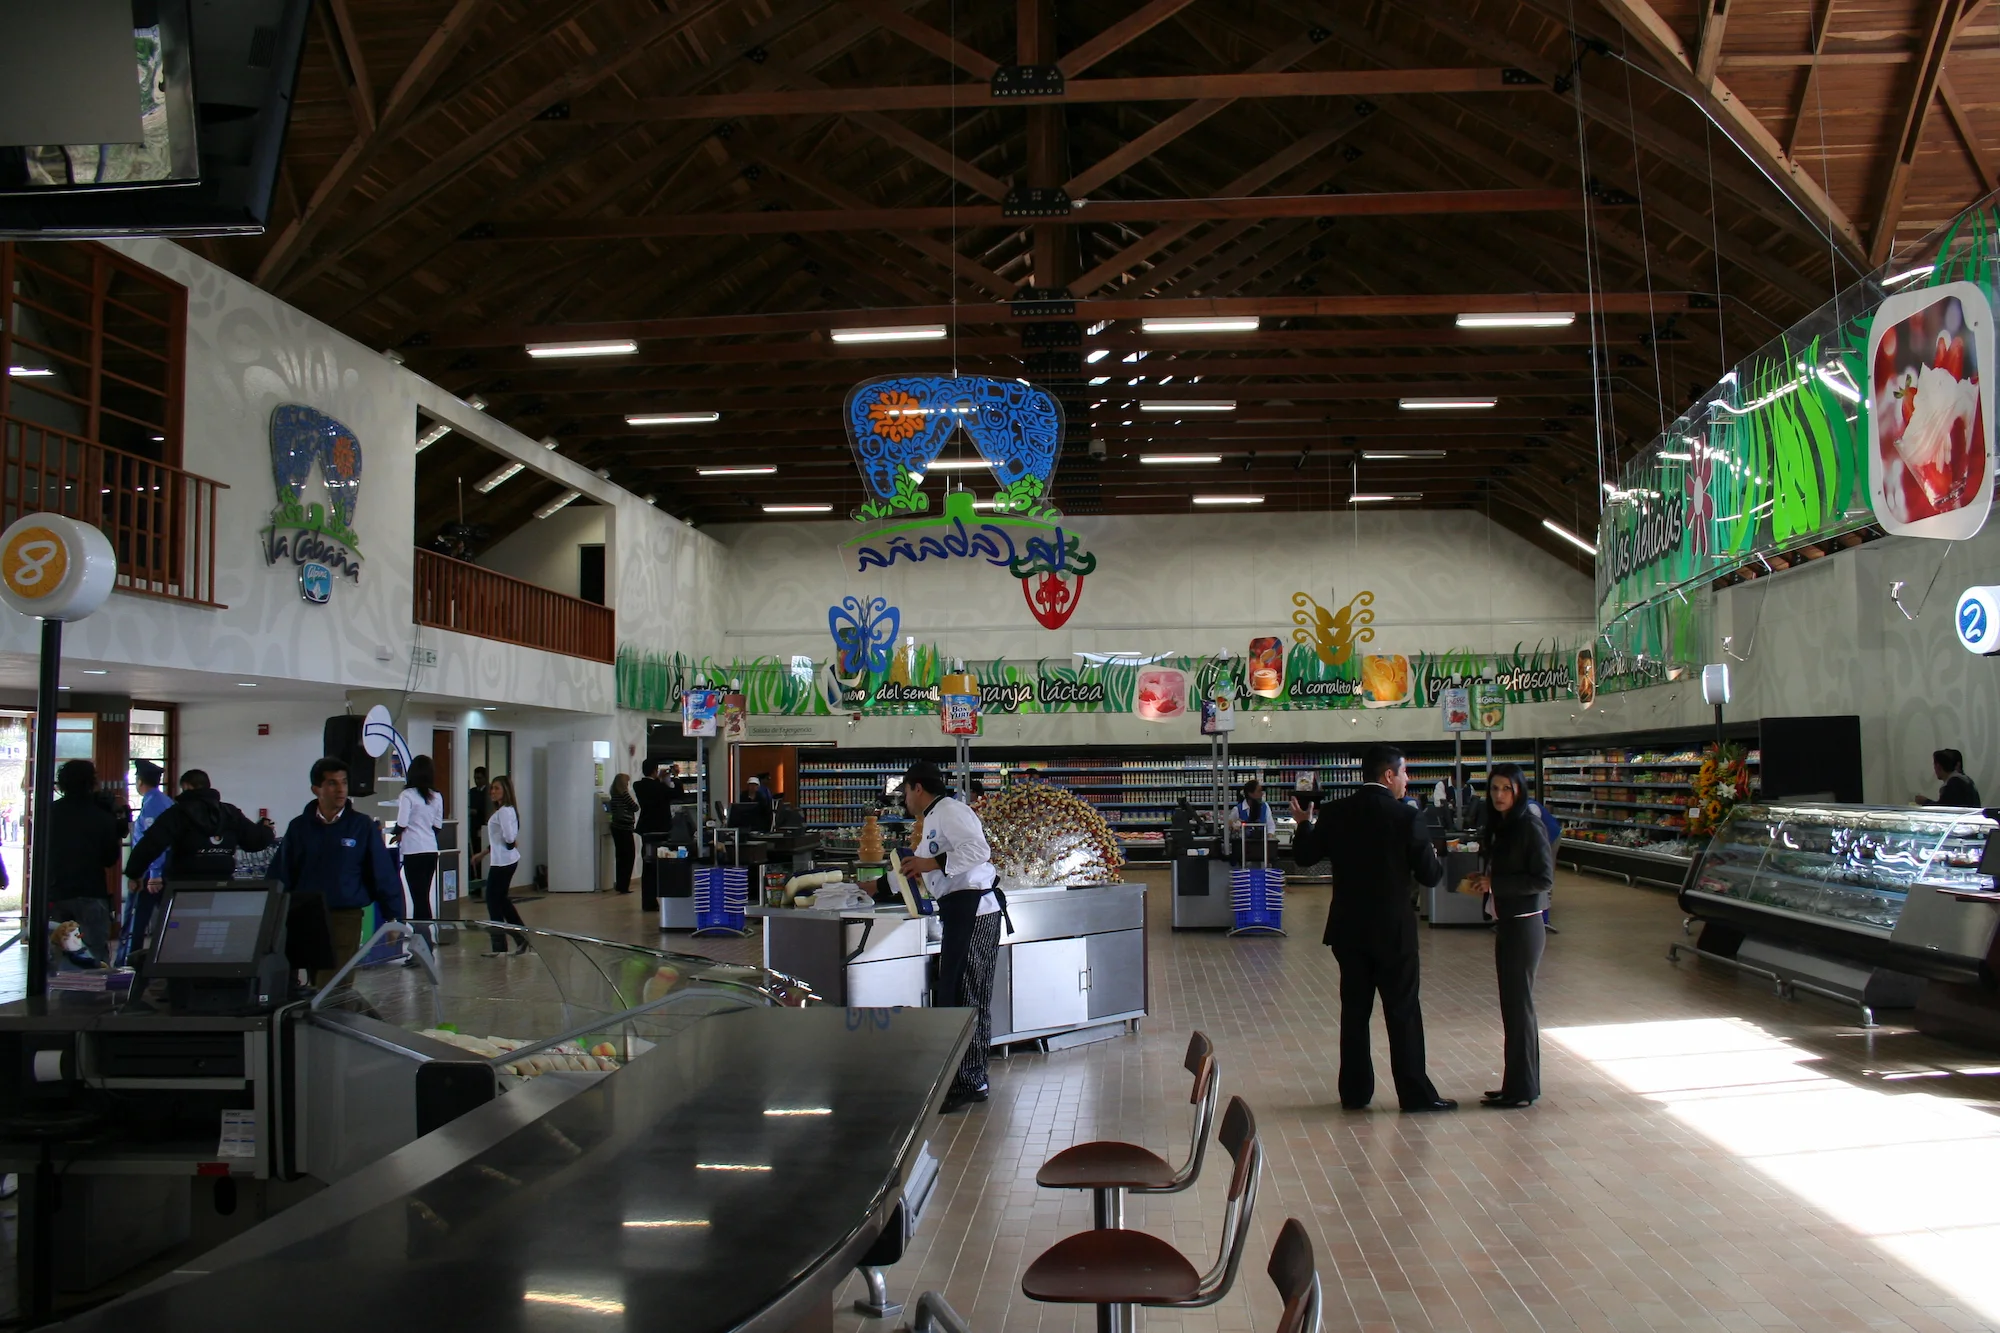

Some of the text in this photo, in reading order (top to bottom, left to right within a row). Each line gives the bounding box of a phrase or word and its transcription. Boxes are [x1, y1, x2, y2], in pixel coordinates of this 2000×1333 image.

[1613, 523, 1631, 578] las
[1632, 498, 1682, 570] delicias
[13, 538, 58, 585] 8
[269, 524, 360, 584] la Cabaña
[1962, 603, 1982, 640] 2
[1290, 682, 1303, 695] el
[1306, 681, 1352, 695] corralito
[1496, 665, 1569, 690] refrescante
[877, 683, 900, 700] del
[1040, 679, 1104, 702] láctea
[949, 712, 970, 720] YURT
[952, 705, 968, 713] BON
